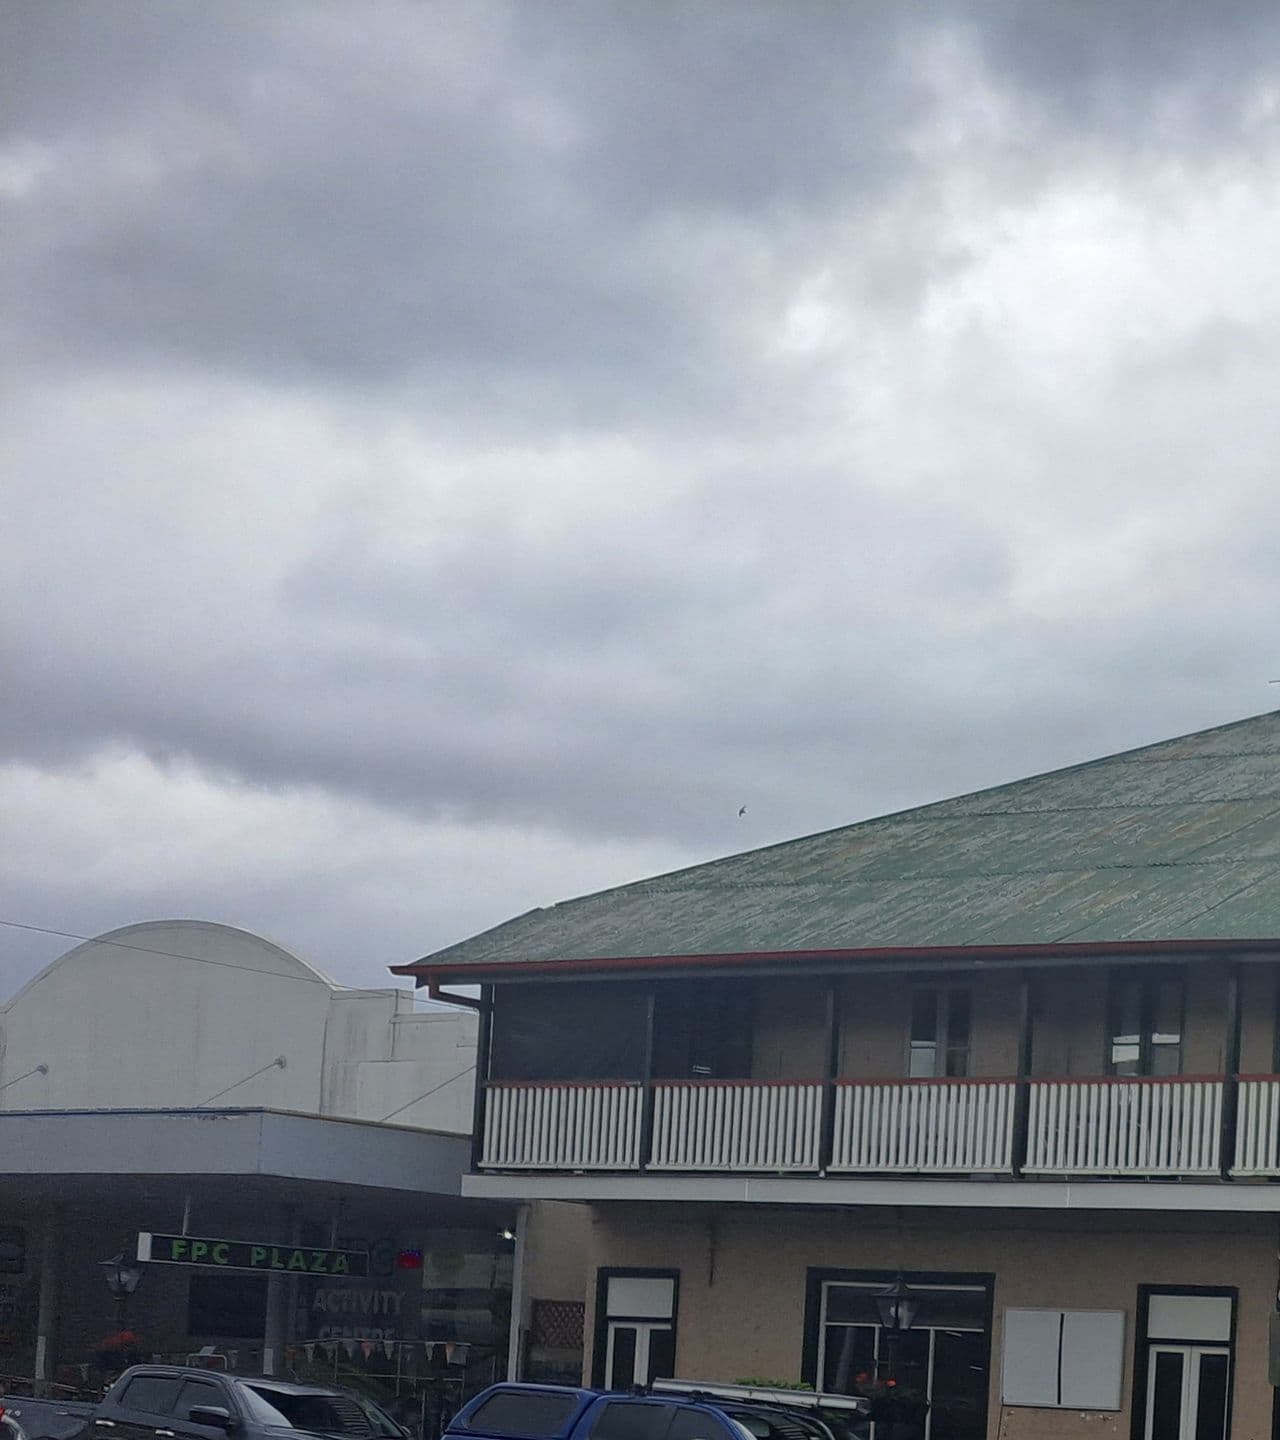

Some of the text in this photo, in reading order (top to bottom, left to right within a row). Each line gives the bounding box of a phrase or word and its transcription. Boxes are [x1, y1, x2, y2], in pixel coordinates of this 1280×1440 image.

[171, 1239, 230, 1265] FPC
[250, 1246, 351, 1274] PLAZA
[312, 1290, 406, 1315] ACTIVITY
